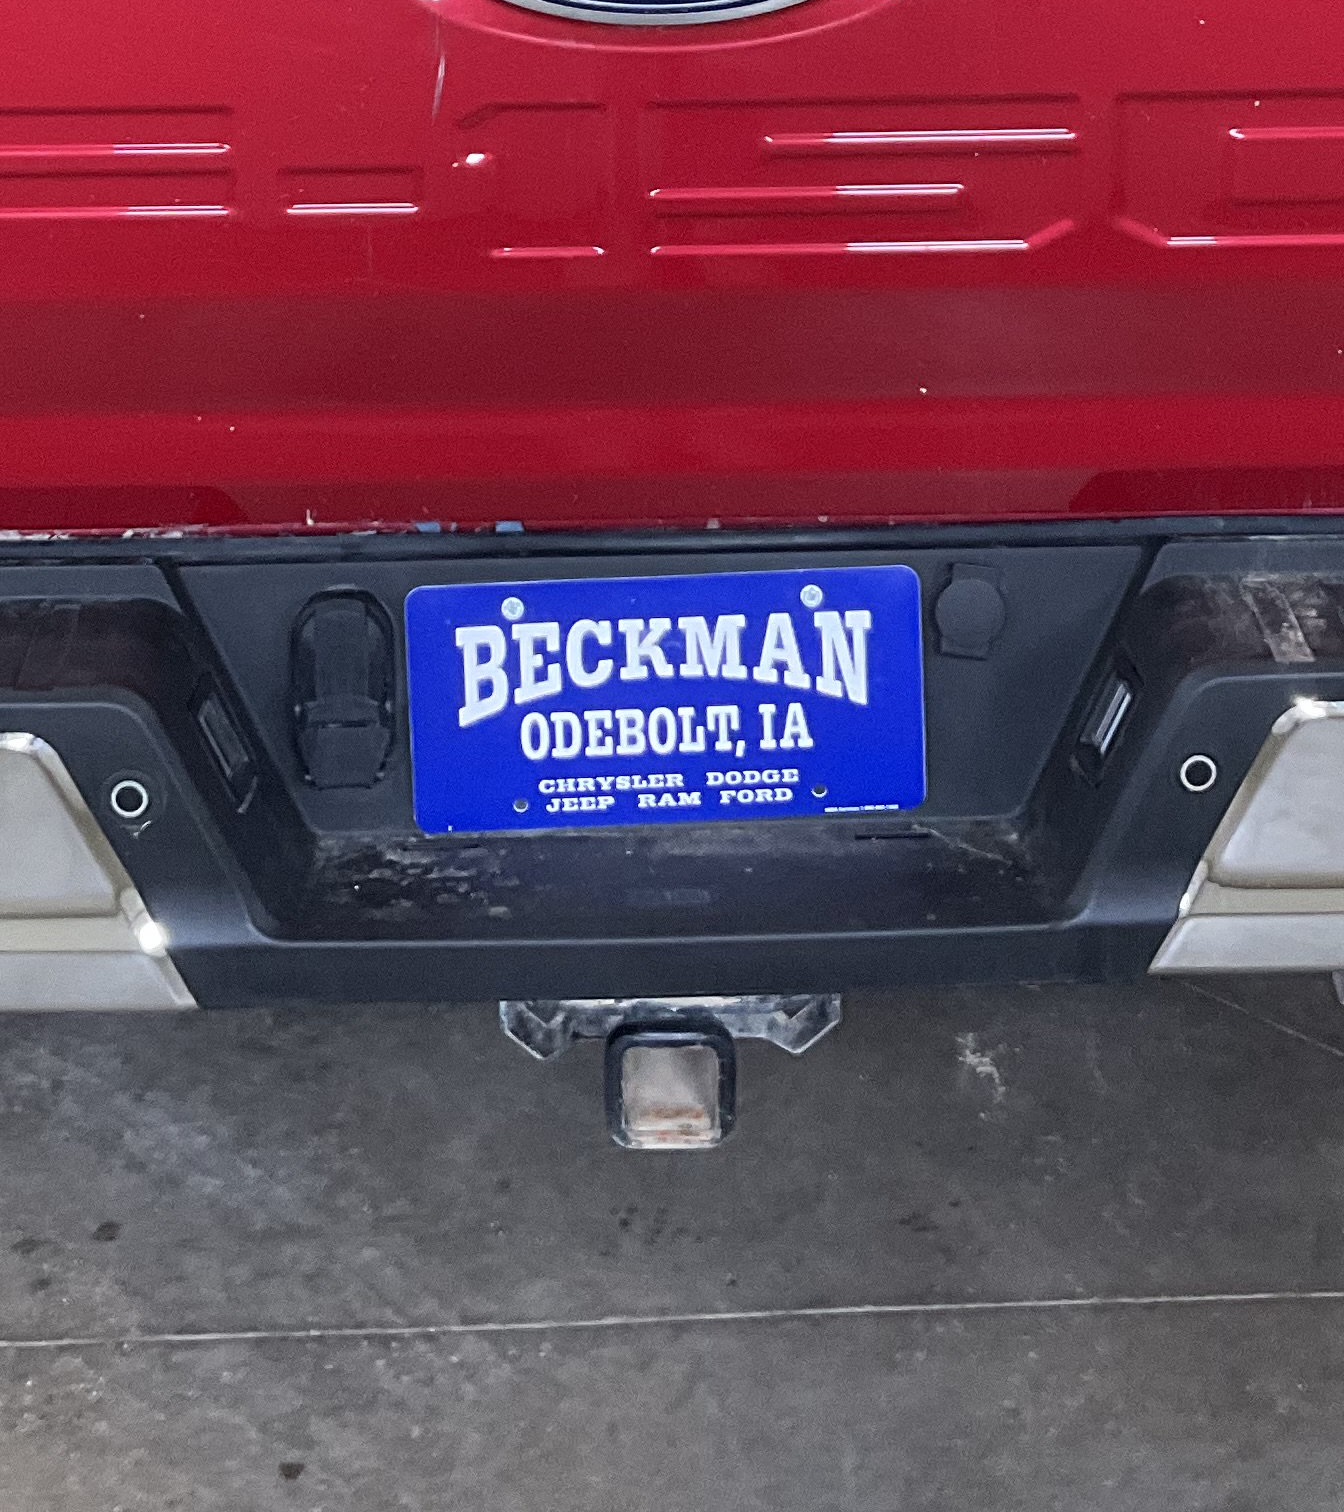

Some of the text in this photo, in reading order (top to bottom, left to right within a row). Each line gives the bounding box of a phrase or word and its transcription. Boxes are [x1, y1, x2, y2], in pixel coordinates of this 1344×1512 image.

[455, 609, 872, 729] BECKMAN
[520, 701, 814, 760] ODEBOLT, IA
[538, 768, 800, 794] CHRYSLER DODGE
[545, 787, 794, 813] JEEP RAM FORD
